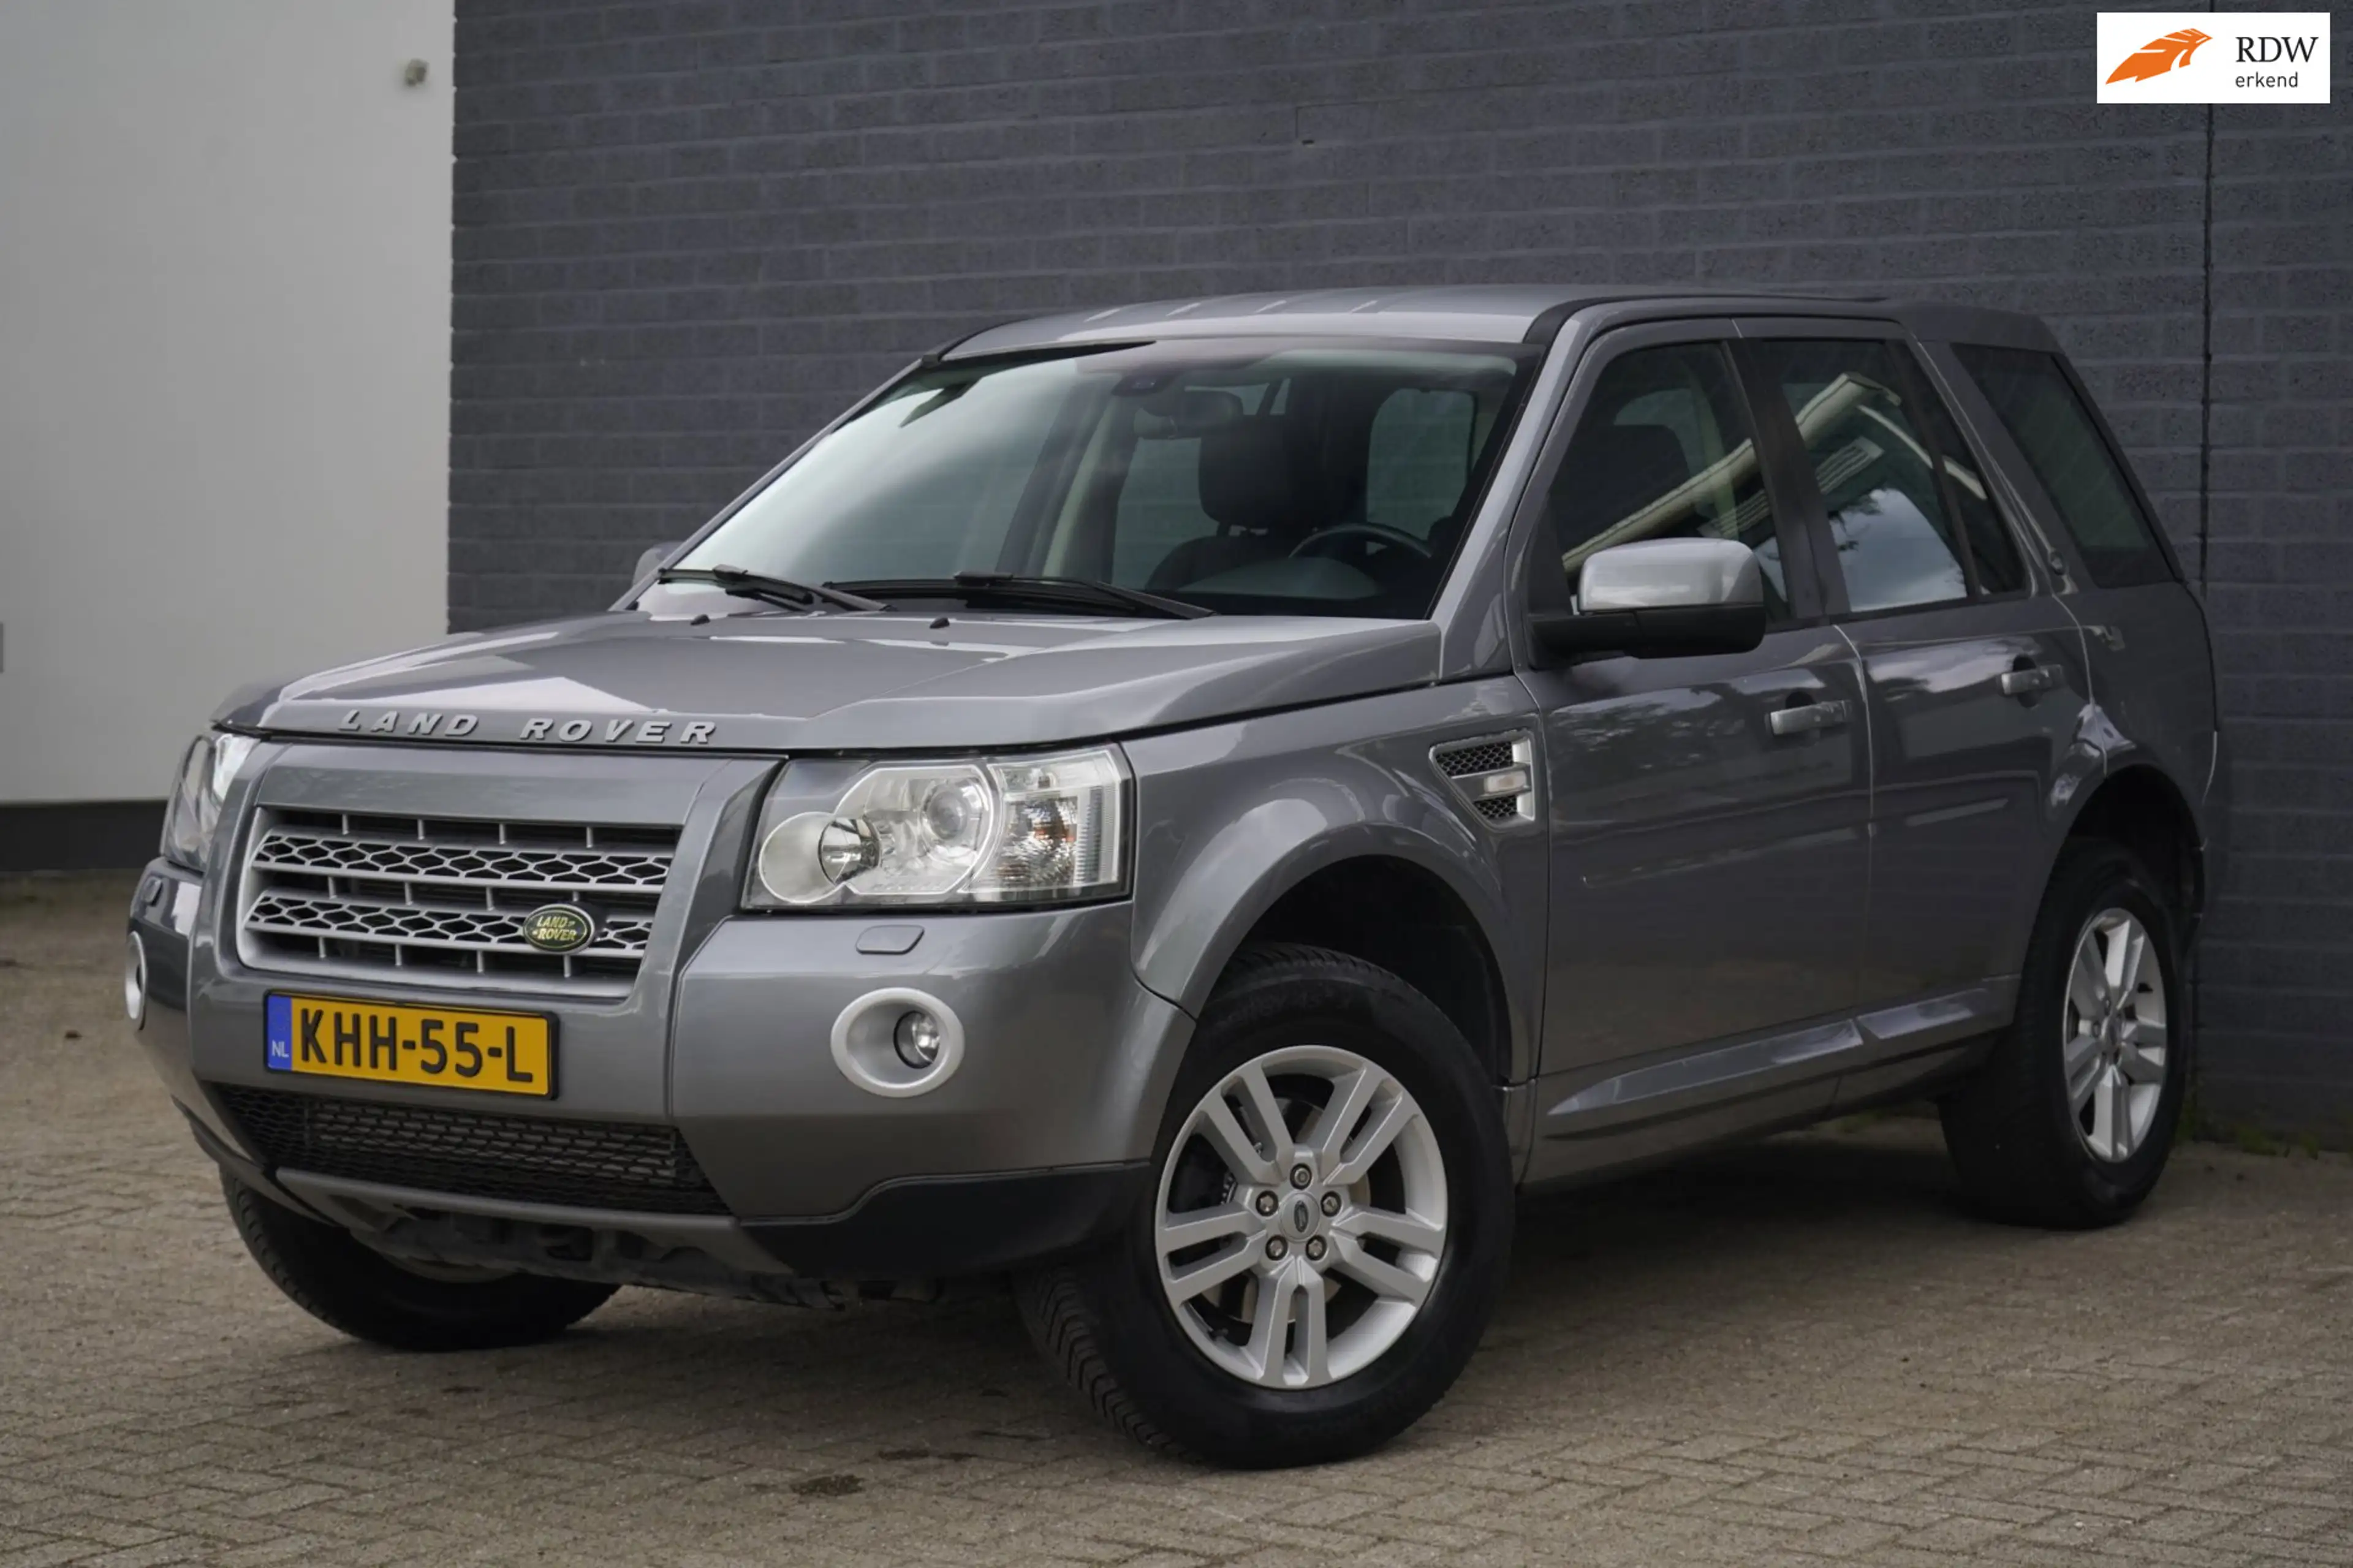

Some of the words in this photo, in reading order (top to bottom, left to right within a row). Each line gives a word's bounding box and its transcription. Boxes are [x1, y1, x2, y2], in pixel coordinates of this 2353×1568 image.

[338, 709, 479, 736] LAND
[519, 718, 717, 744] ROVER
[537, 928, 577, 941] ROVER
[271, 1040, 289, 1058] NL
[301, 1008, 533, 1083] KHH-55-L
